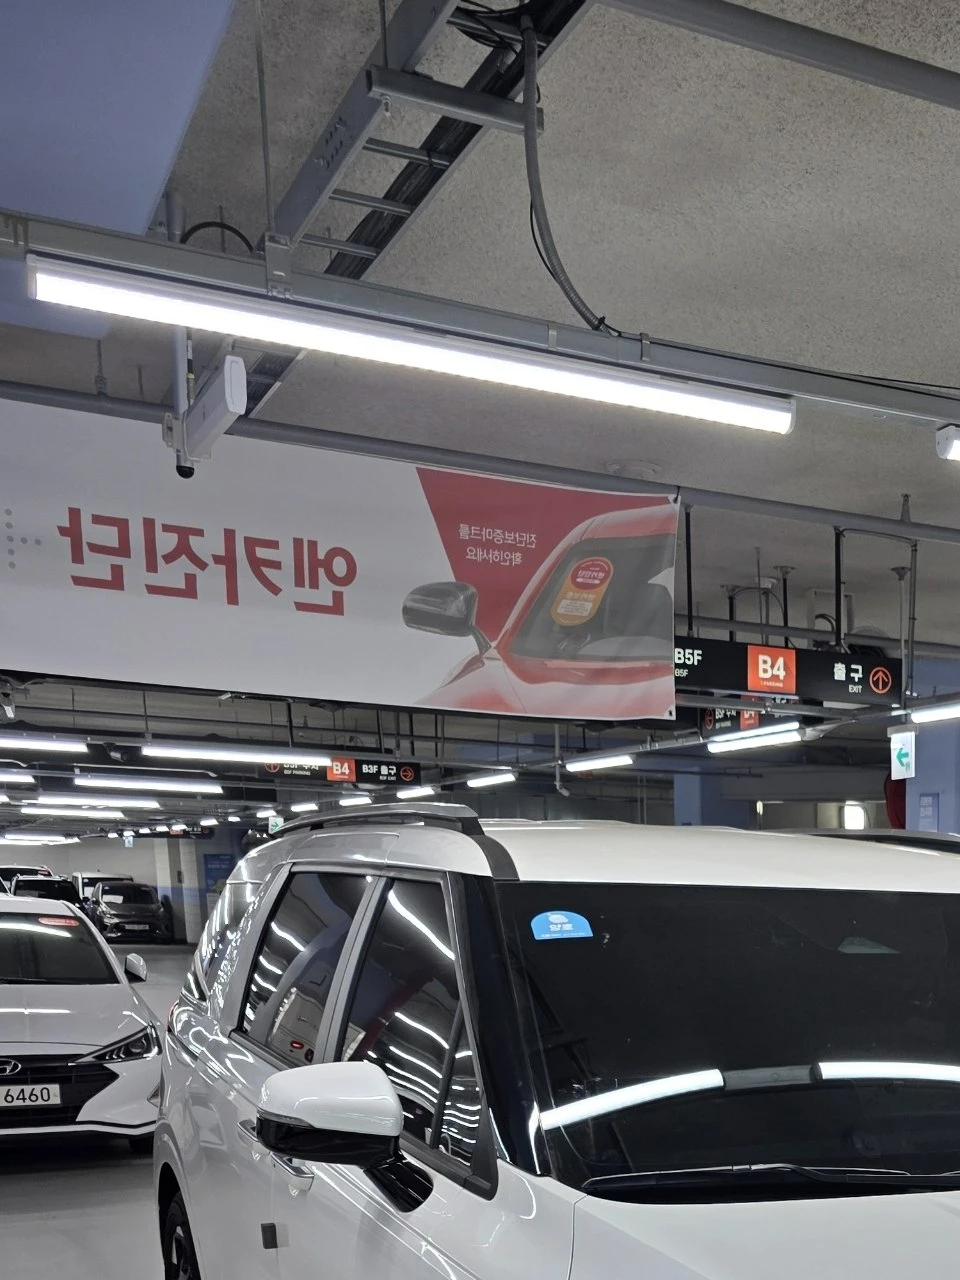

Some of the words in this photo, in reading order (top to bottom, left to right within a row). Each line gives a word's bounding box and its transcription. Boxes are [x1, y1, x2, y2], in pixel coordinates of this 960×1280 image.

[674, 648, 702, 665] B5F
[758, 654, 786, 680] B4
[848, 684, 863, 693] EXIT
[333, 762, 350, 775] B4
[3, 1086, 51, 1104] 6460
